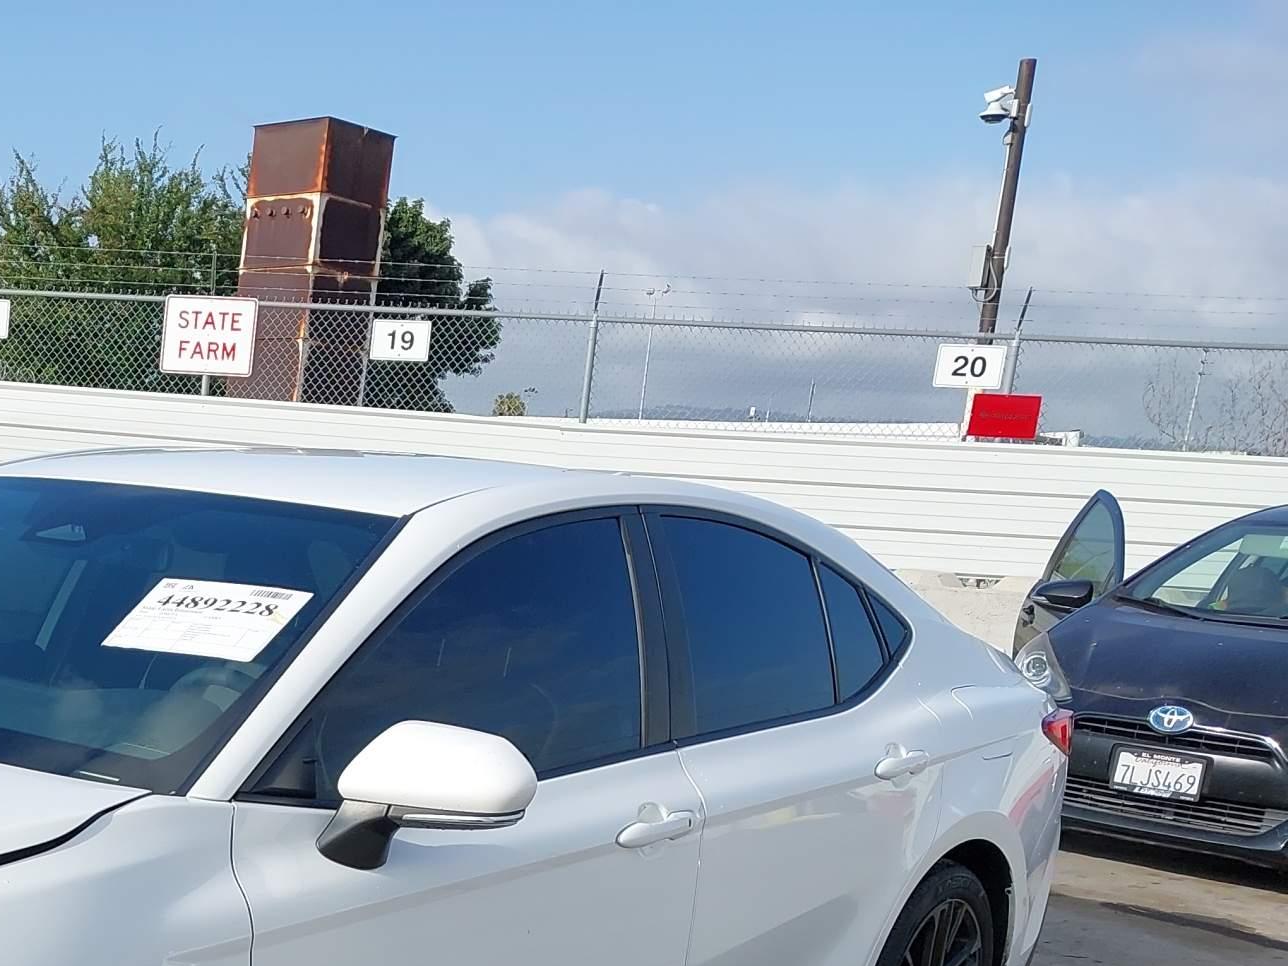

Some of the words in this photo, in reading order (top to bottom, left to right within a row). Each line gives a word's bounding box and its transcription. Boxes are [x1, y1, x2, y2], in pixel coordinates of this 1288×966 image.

[177, 310, 243, 332] STATE
[177, 339, 238, 362] FARM
[388, 330, 415, 351] 19
[951, 355, 987, 378] 20
[157, 593, 279, 617] 44892228
[1120, 763, 1197, 793] 7LJS469
